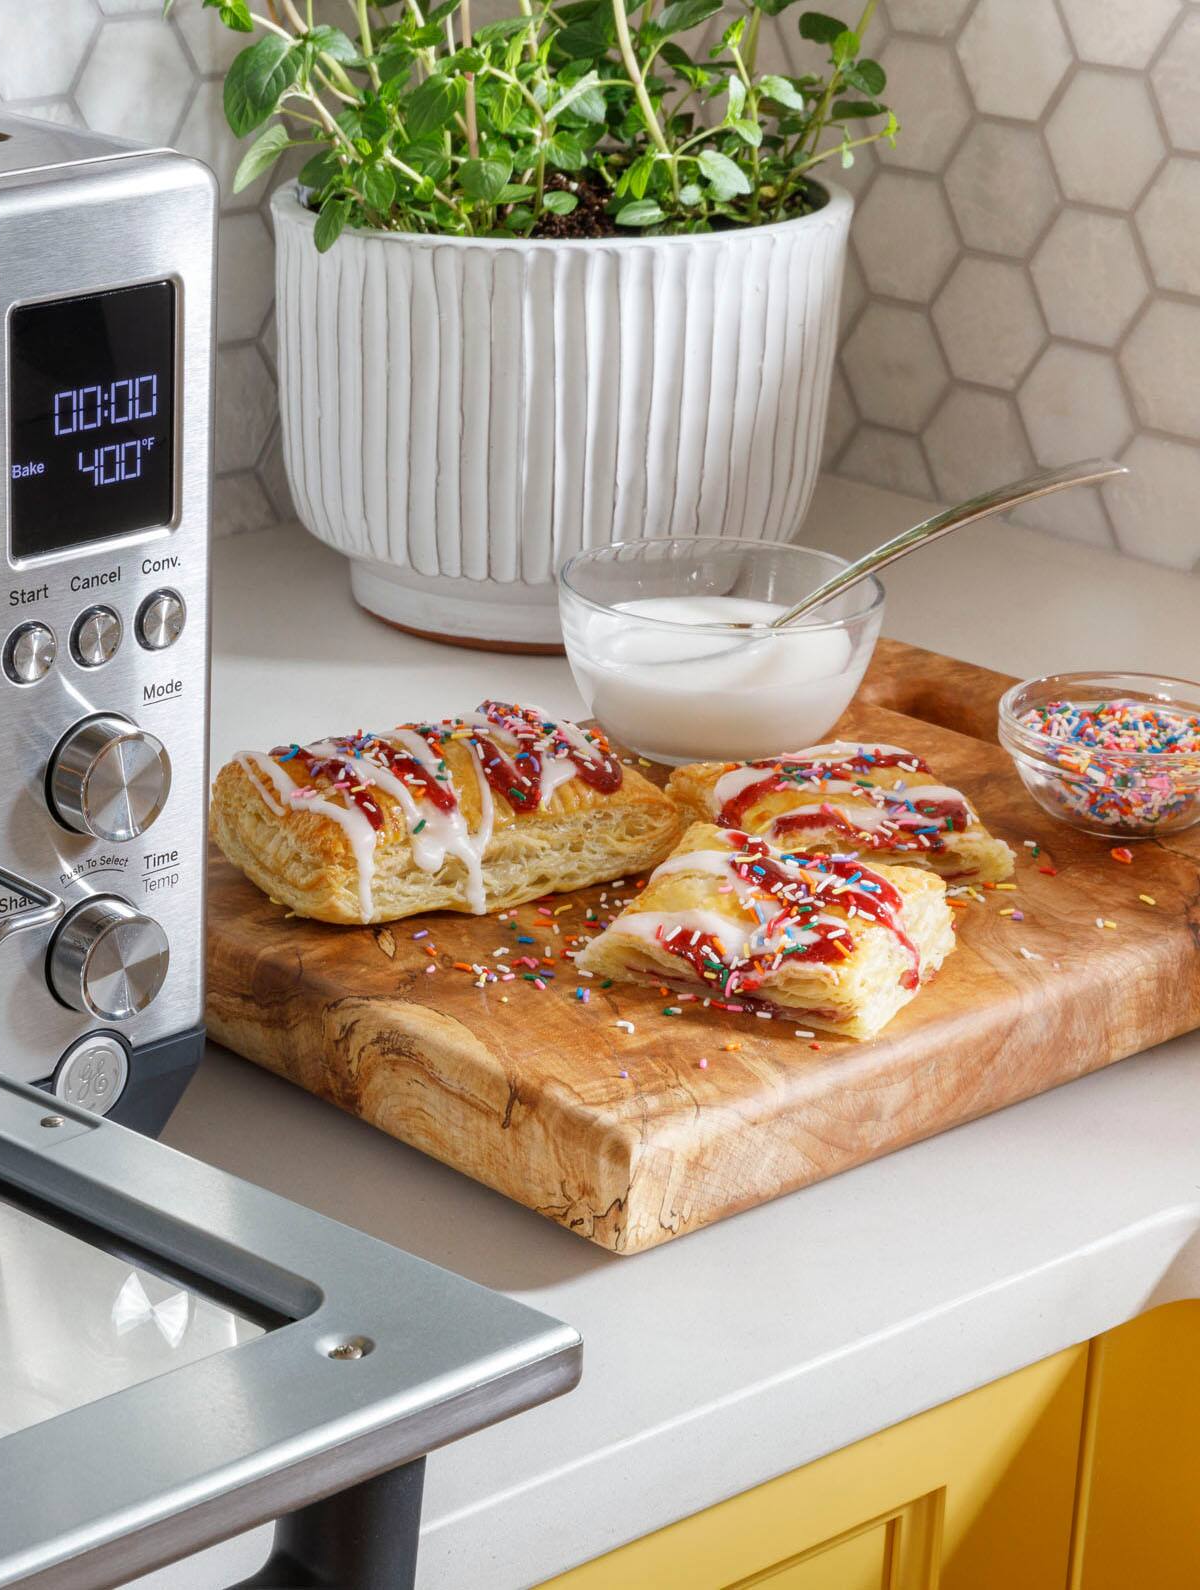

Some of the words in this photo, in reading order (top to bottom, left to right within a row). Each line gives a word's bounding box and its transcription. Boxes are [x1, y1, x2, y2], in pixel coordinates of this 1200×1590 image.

[54, 374, 157, 436] 00:00
[11, 461, 45, 479] Bake
[141, 556, 181, 575] Conv.
[70, 566, 121, 592] Cancel
[9, 584, 49, 606] Start
[143, 679, 183, 700] Mode
[60, 863, 84, 884] Push
[86, 858, 97, 869] To
[100, 855, 129, 867] Select
[144, 850, 179, 870] Time
[142, 872, 179, 893] Temp
